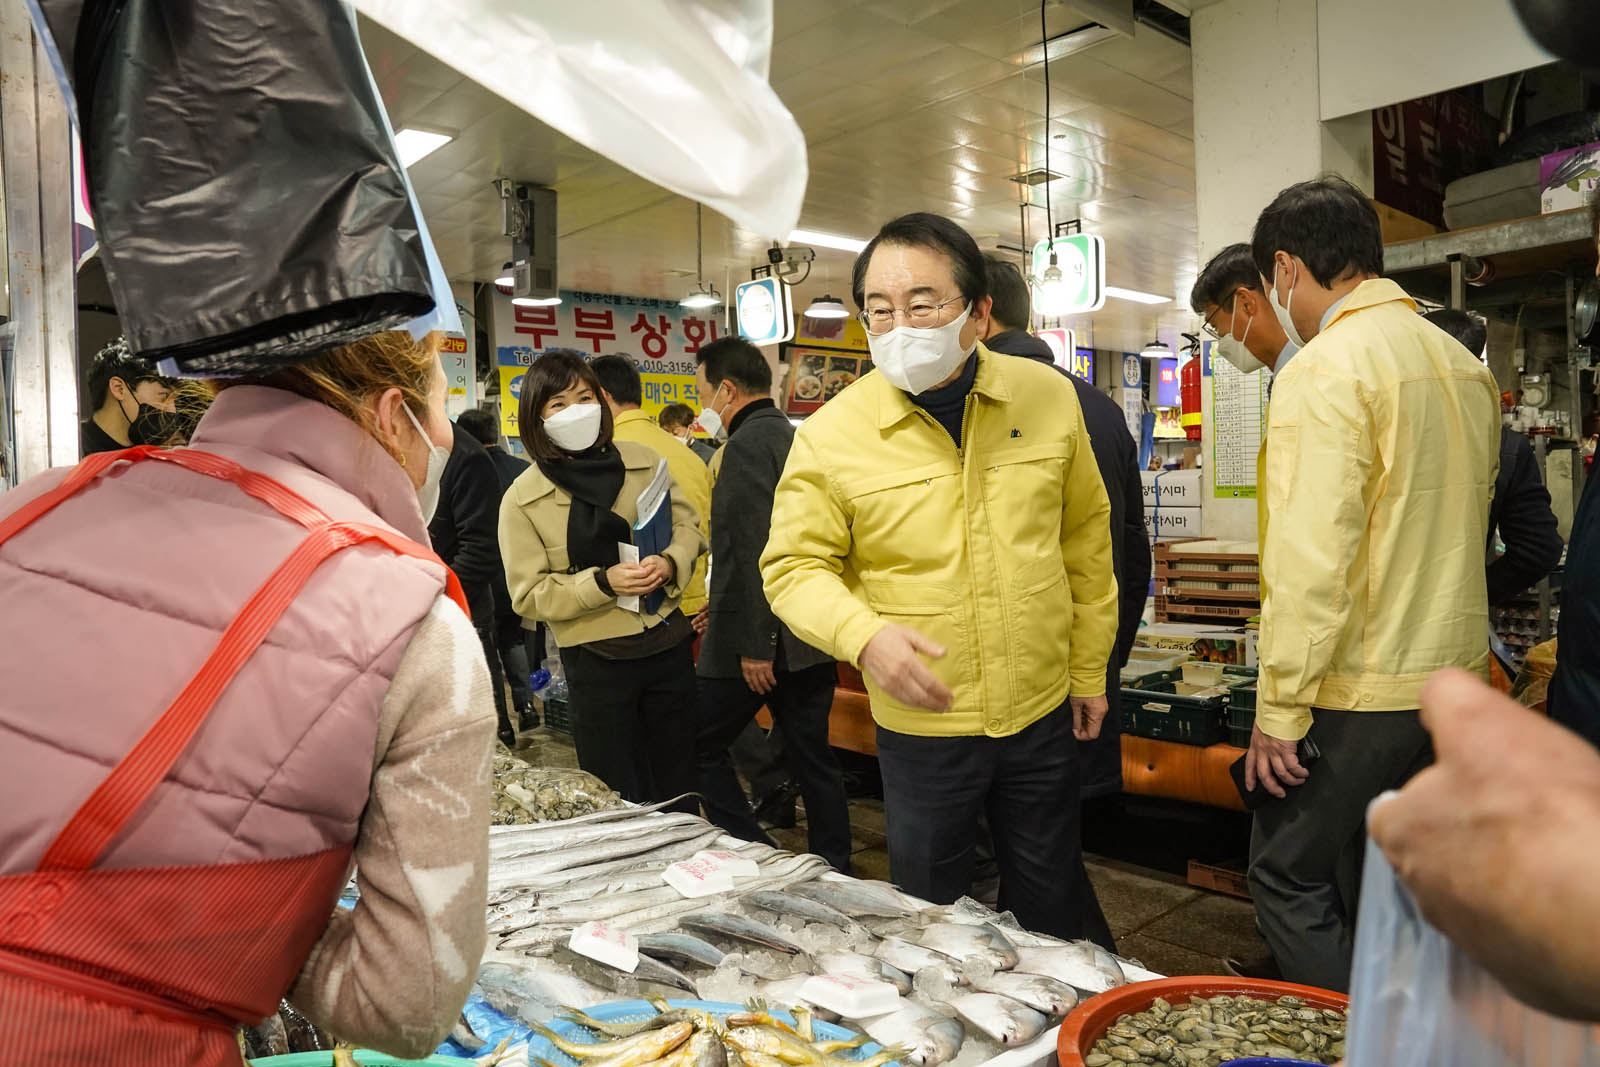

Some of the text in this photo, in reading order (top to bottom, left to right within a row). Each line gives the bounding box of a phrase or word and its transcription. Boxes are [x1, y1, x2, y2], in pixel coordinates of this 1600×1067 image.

[514, 304, 718, 358] 부부상회
[644, 360, 698, 373] 010-3156-
[645, 382, 678, 405] 매인
